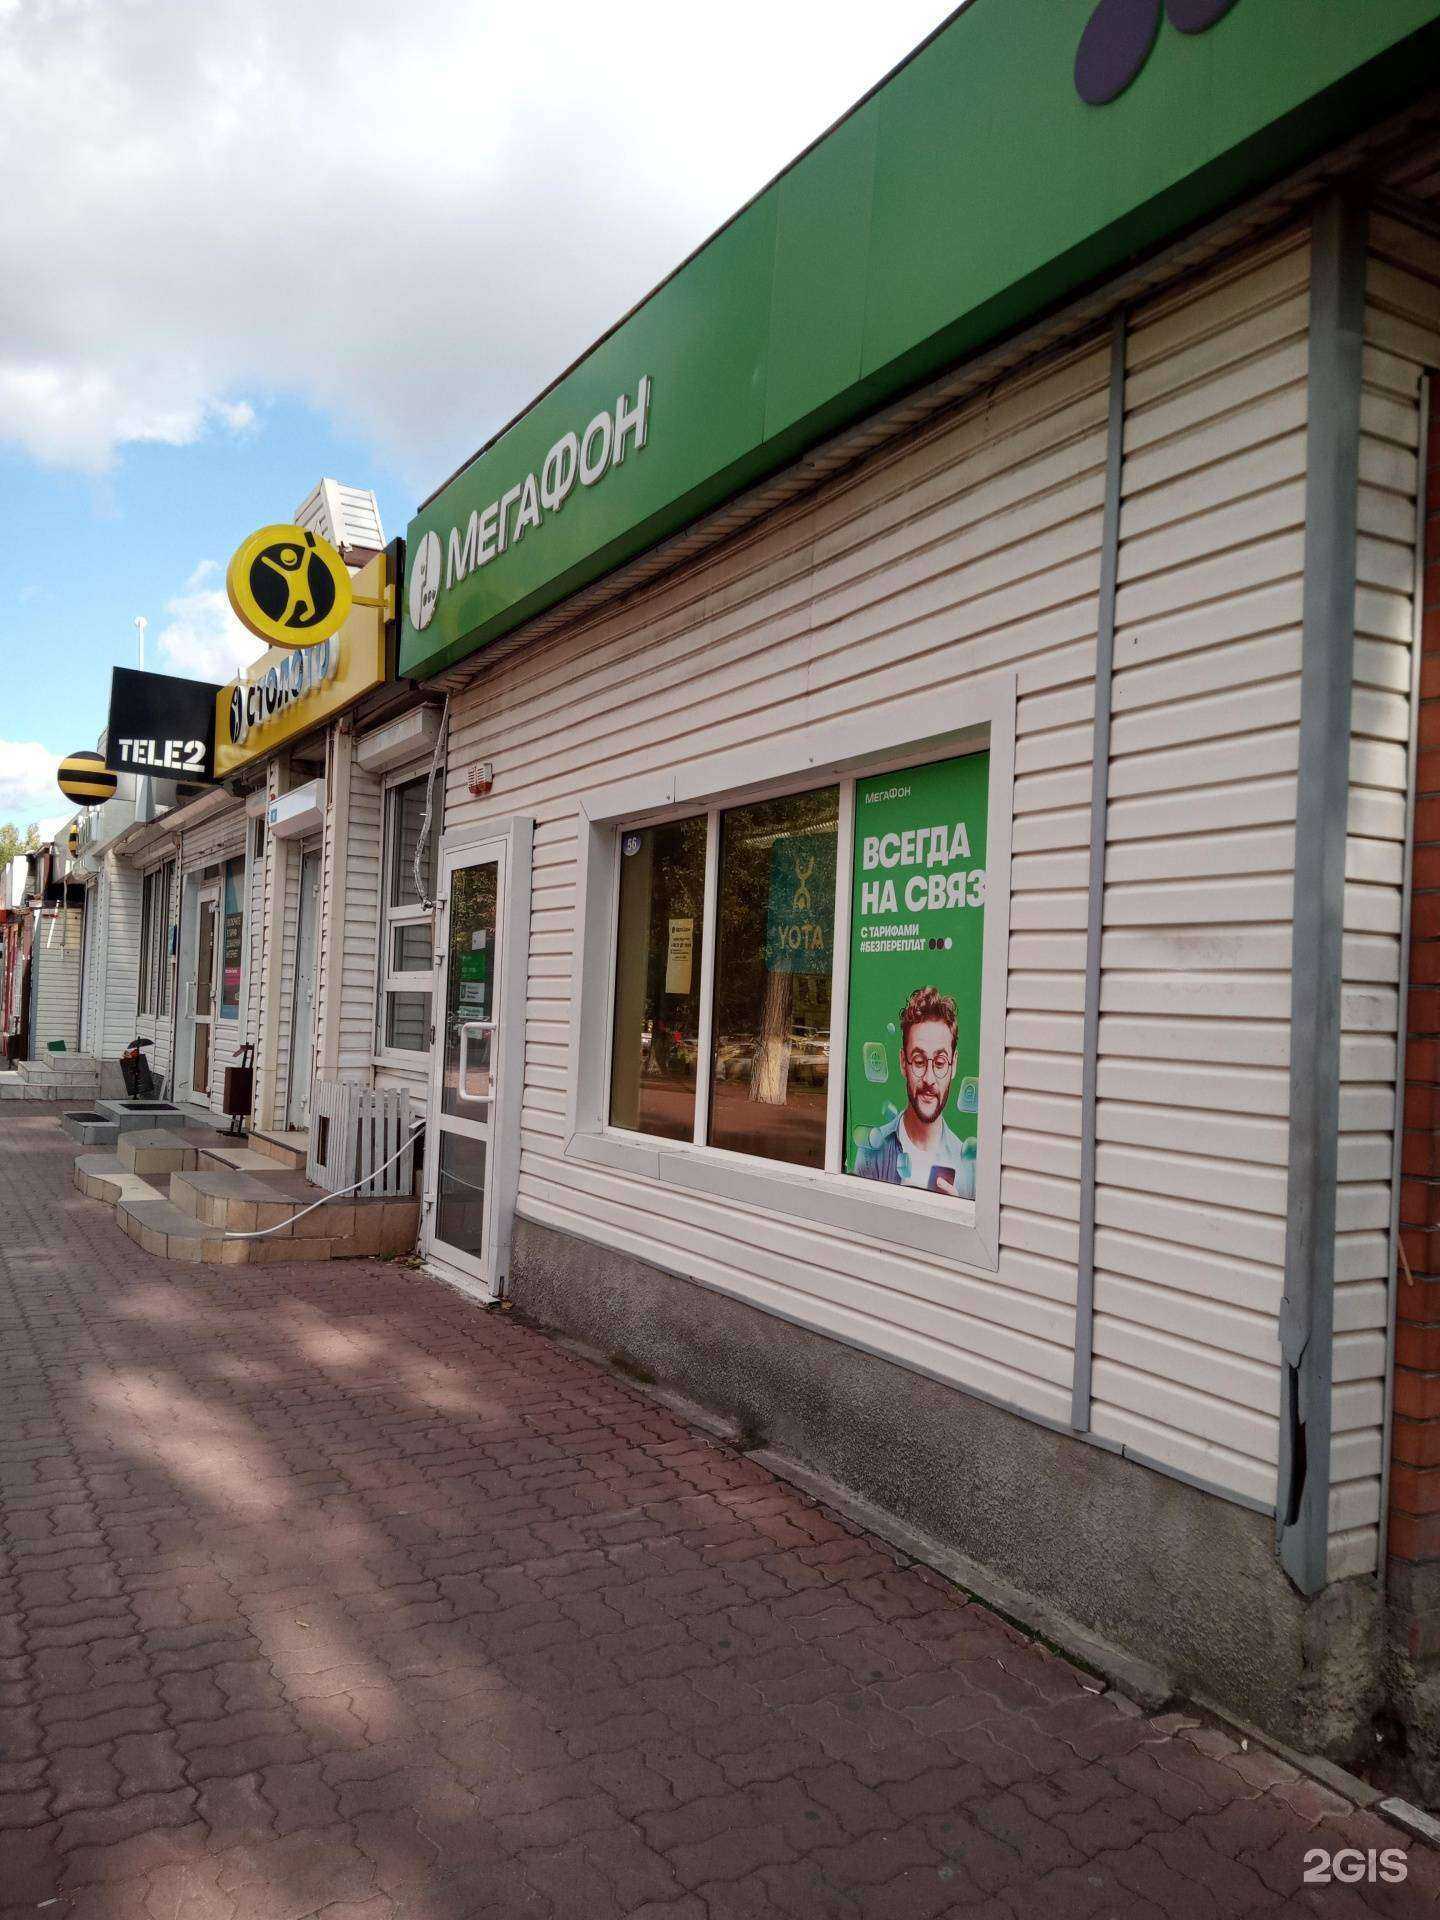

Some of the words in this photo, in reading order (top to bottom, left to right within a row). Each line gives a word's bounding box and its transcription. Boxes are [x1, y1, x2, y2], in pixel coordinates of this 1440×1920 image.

[446, 374, 651, 590] МЕГАФОН
[118, 739, 206, 773] TELE2
[863, 822, 971, 870] ВСЕГДА
[861, 879, 898, 915] НА
[779, 924, 824, 950] YOTA
[860, 938, 926, 953] #БЕЗПЕРЕПЛАТ
[869, 924, 920, 938] ТАРИФАМИ
